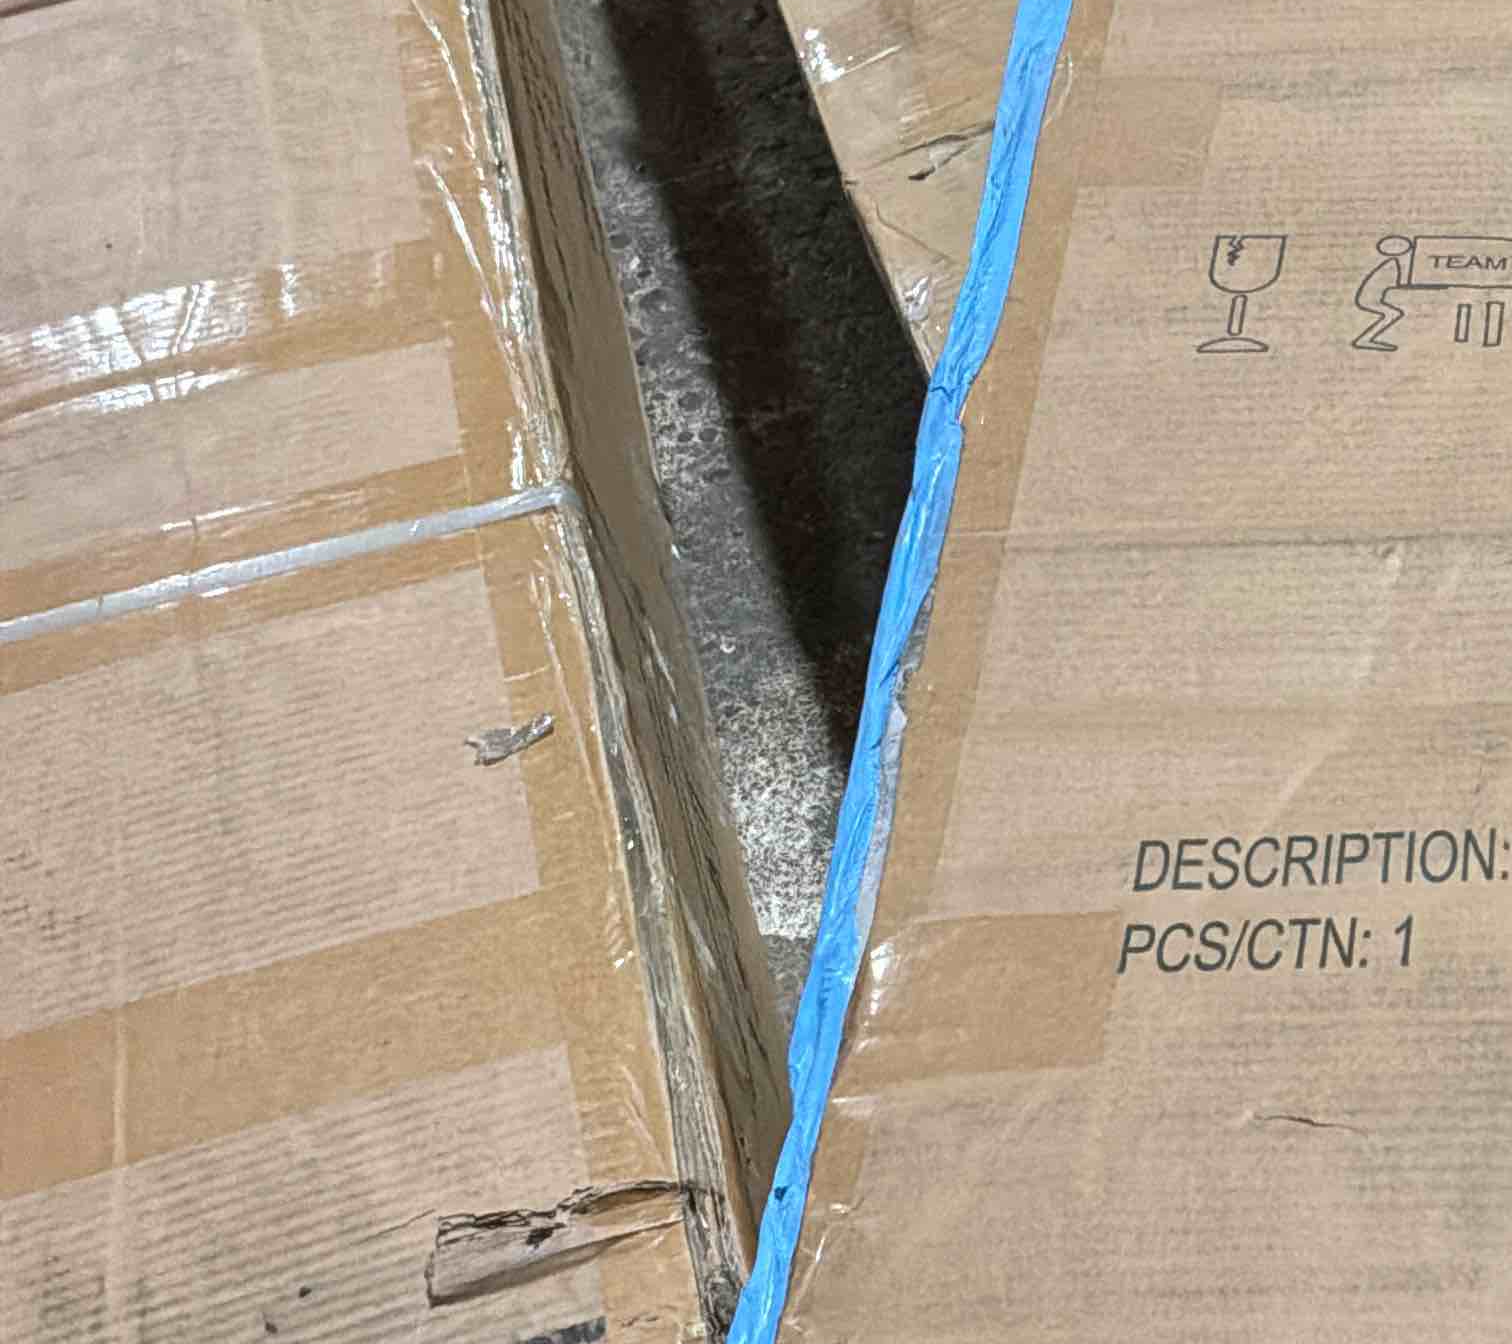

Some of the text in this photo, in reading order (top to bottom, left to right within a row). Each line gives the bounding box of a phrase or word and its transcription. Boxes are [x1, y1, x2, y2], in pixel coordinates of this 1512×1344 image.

[1428, 255, 1506, 270] TEAM
[1133, 827, 1511, 892] DESCRIPTION:
[1116, 914, 1414, 975] PCS/CTN: 1
